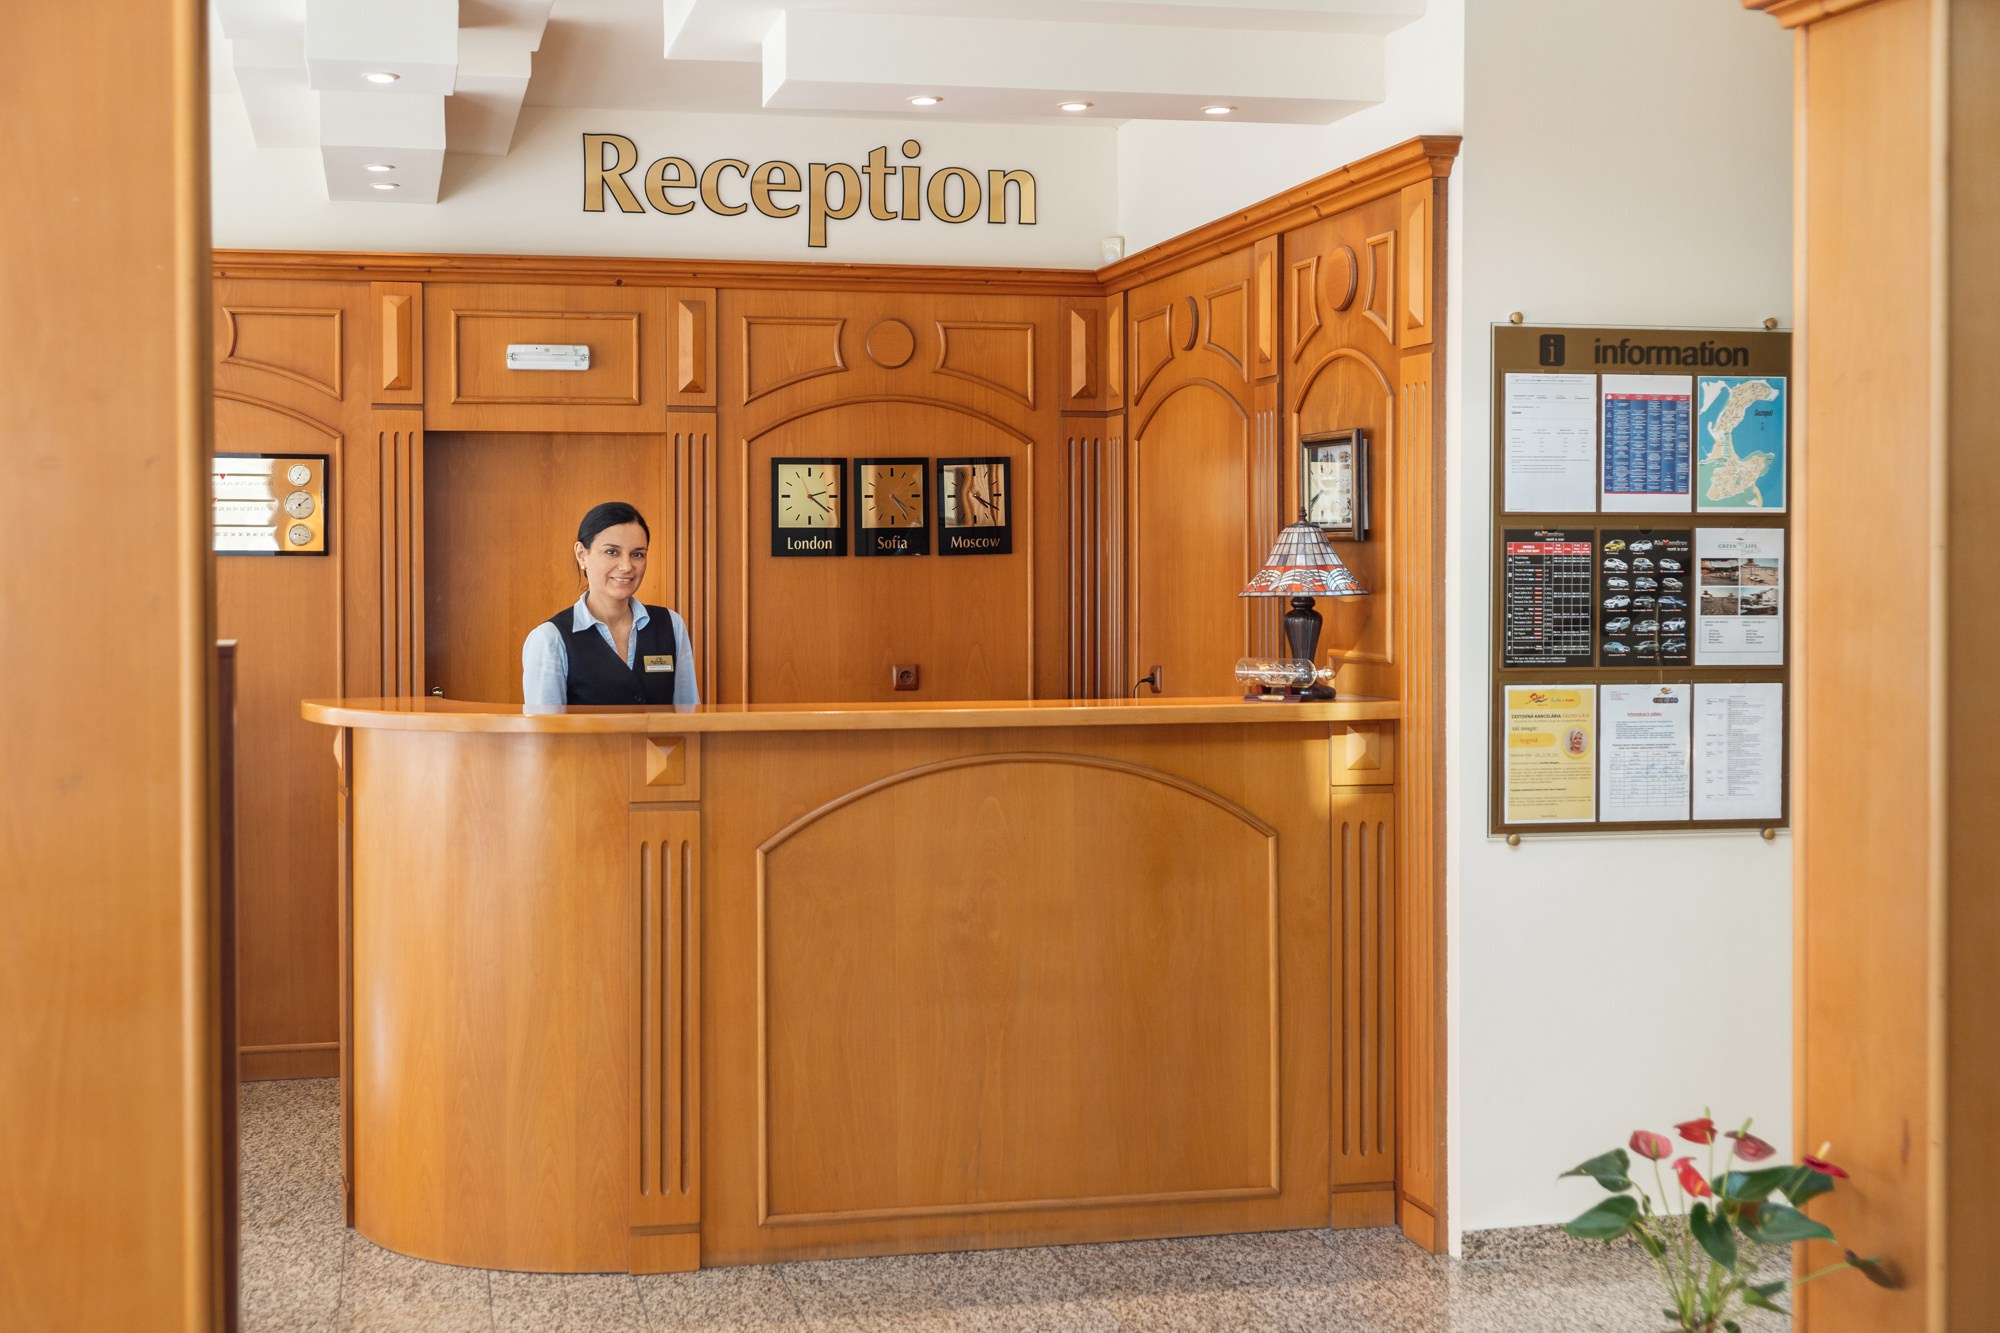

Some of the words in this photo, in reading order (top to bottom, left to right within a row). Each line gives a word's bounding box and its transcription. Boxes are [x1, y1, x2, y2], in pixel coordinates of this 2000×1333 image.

[582, 133, 1037, 248] Reception
[1594, 338, 1749, 367] information
[787, 536, 832, 550] London
[878, 536, 908, 550] Sofia
[950, 536, 1000, 549] Moscow
